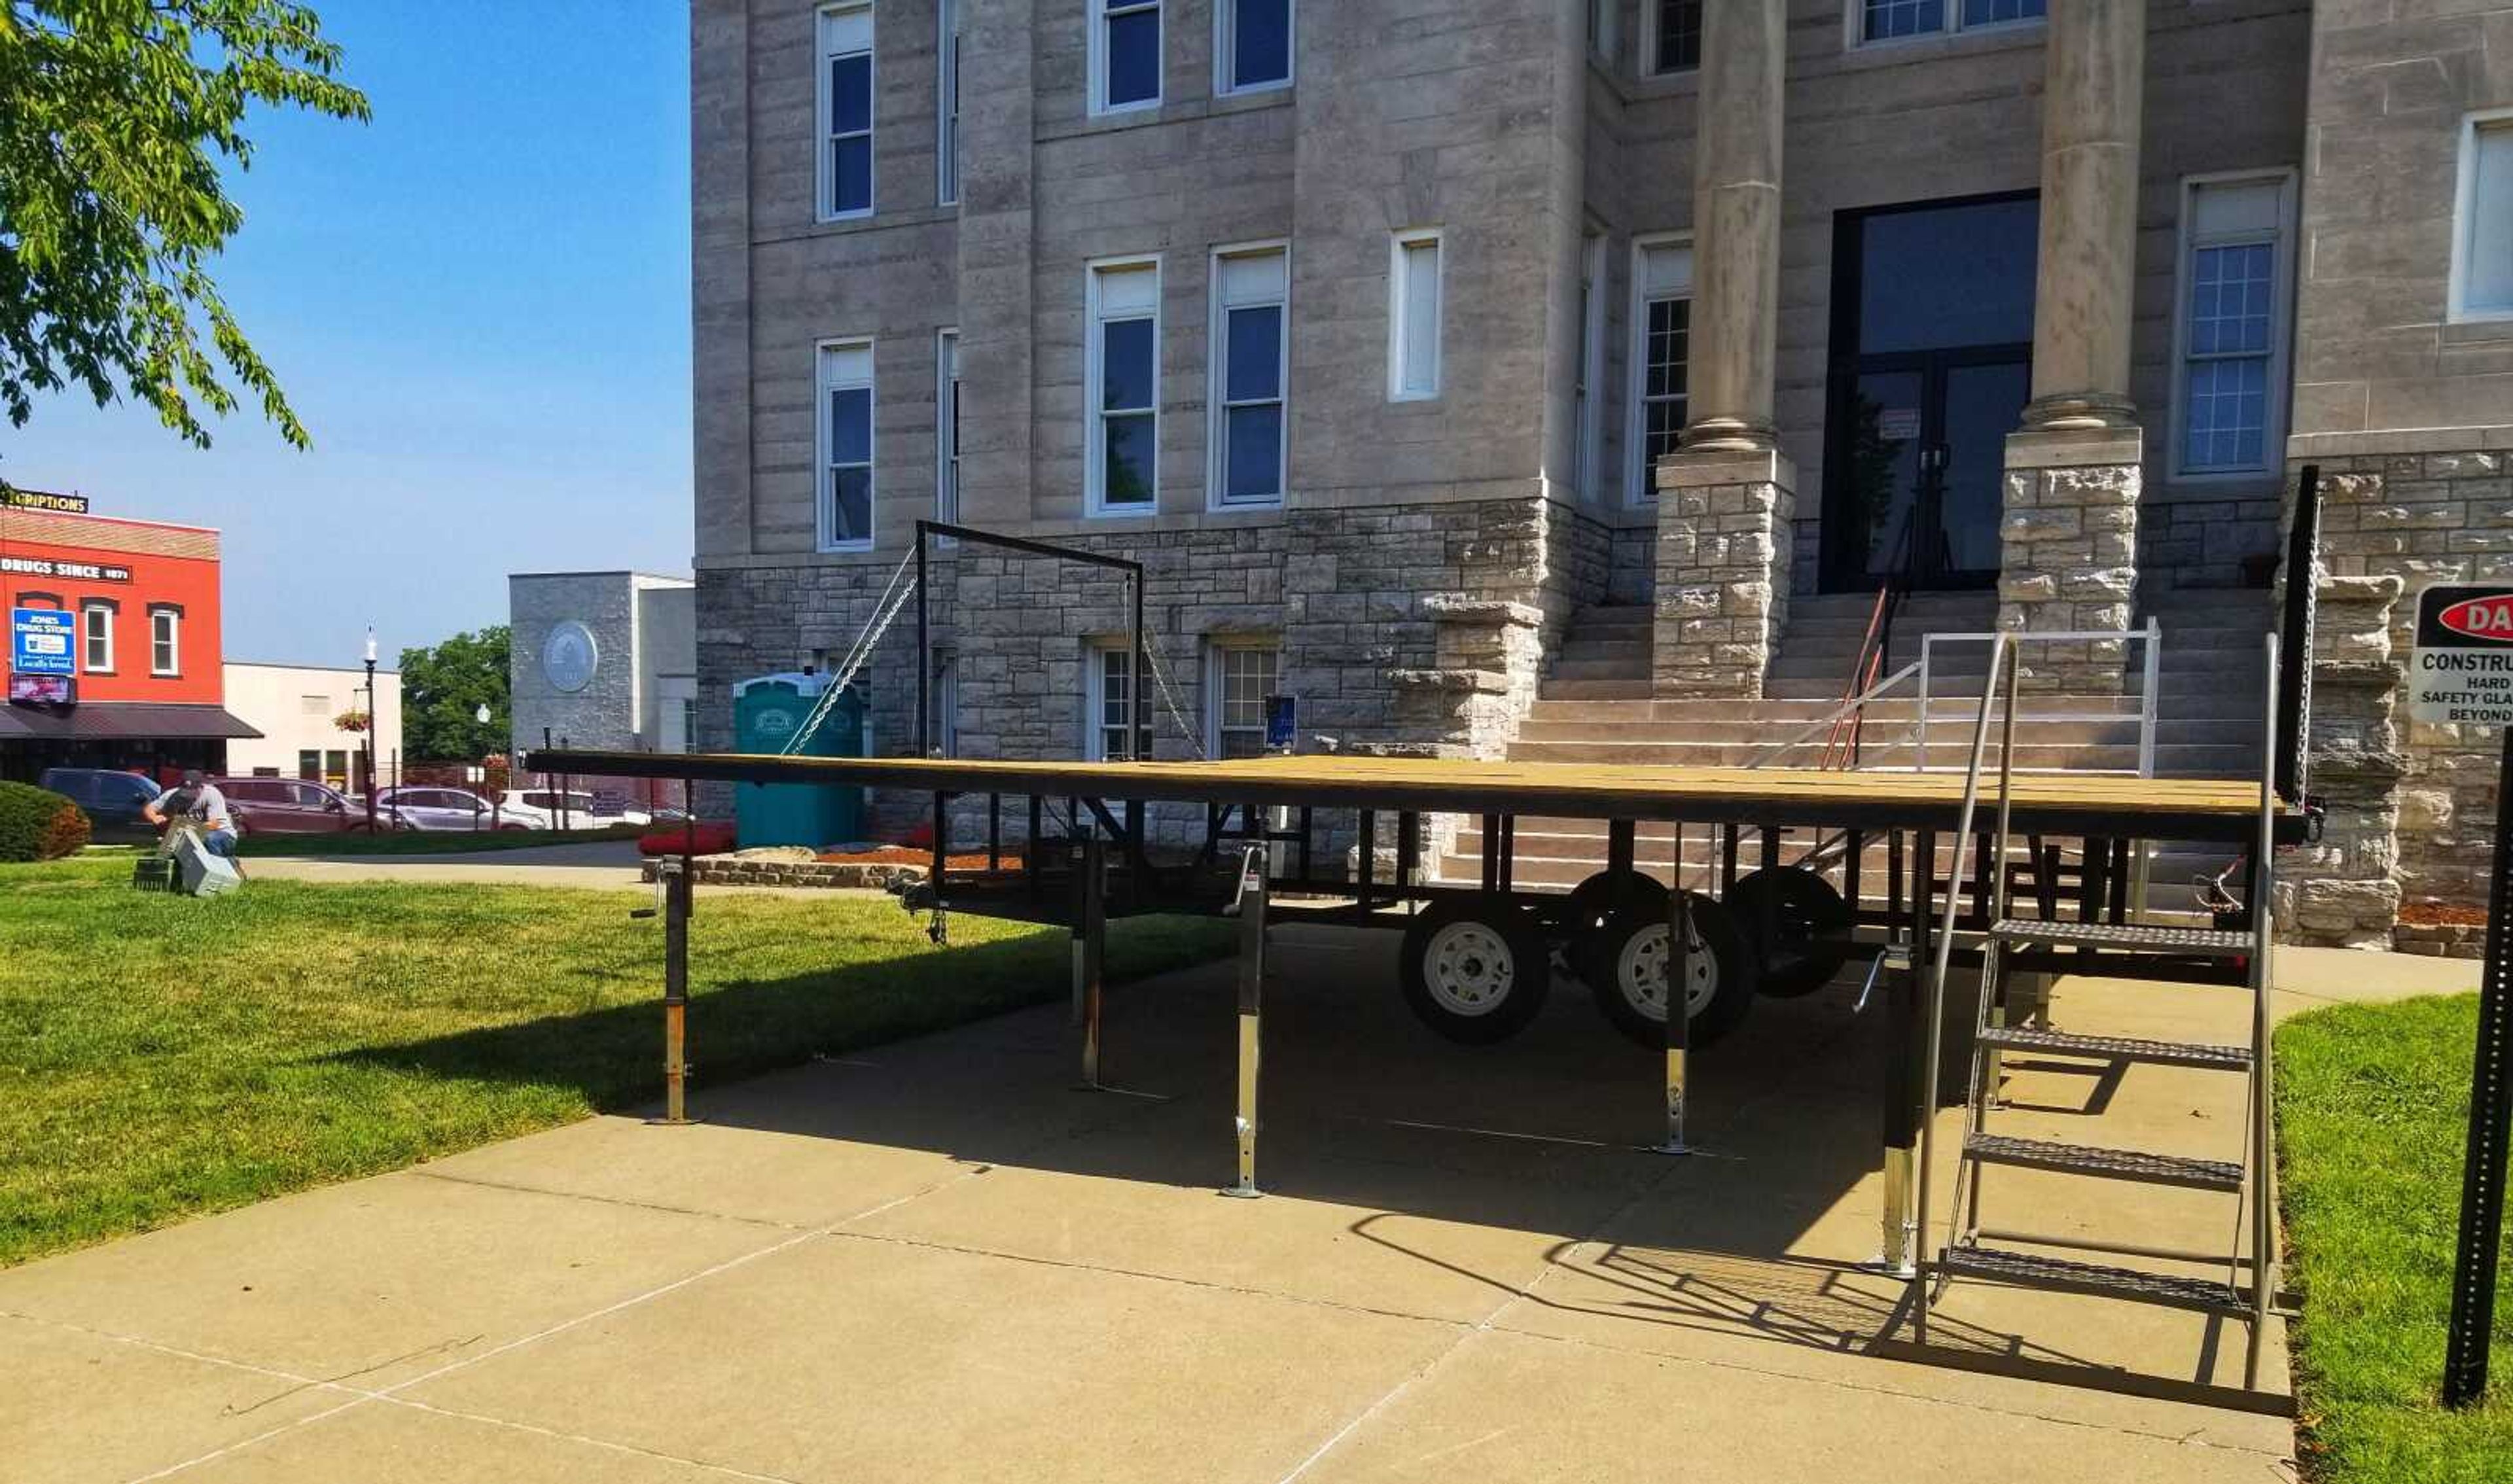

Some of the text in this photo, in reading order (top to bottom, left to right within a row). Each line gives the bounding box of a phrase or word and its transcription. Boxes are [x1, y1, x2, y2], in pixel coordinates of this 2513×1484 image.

[1, 558, 52, 574] DRUGS
[56, 563, 99, 578] SINCE
[2467, 677, 2510, 689] HARD
[2422, 691, 2478, 704] SAFETY
[2450, 709, 2512, 722] BEYOND
